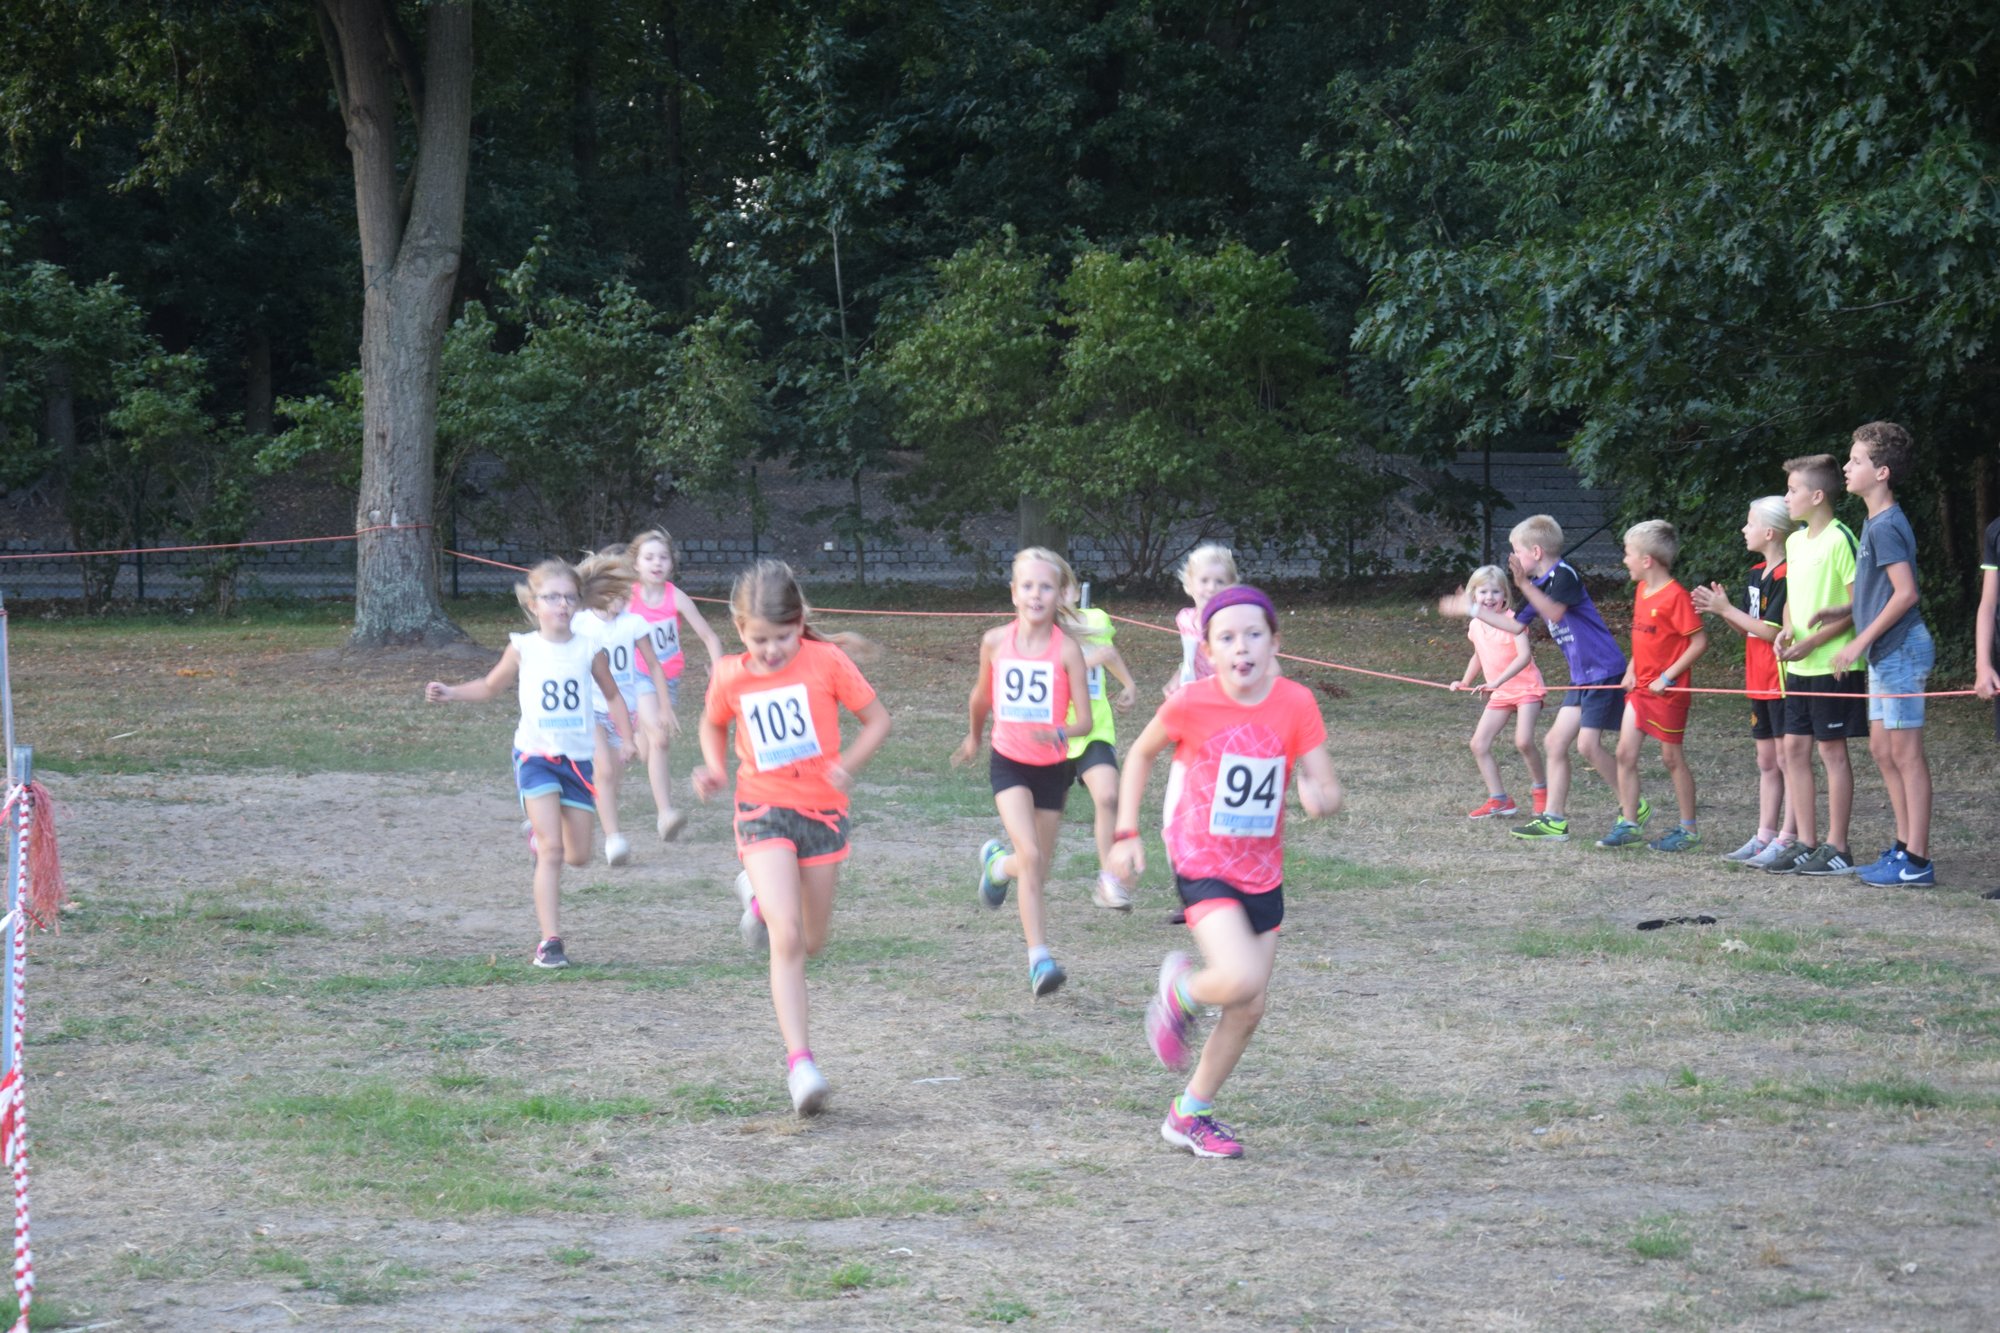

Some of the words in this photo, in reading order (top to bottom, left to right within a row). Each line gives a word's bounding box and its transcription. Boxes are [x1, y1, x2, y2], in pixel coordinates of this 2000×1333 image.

[541, 679, 580, 711] 88
[1006, 668, 1047, 703] 95
[750, 697, 805, 744] 103
[1224, 764, 1277, 809] 94
